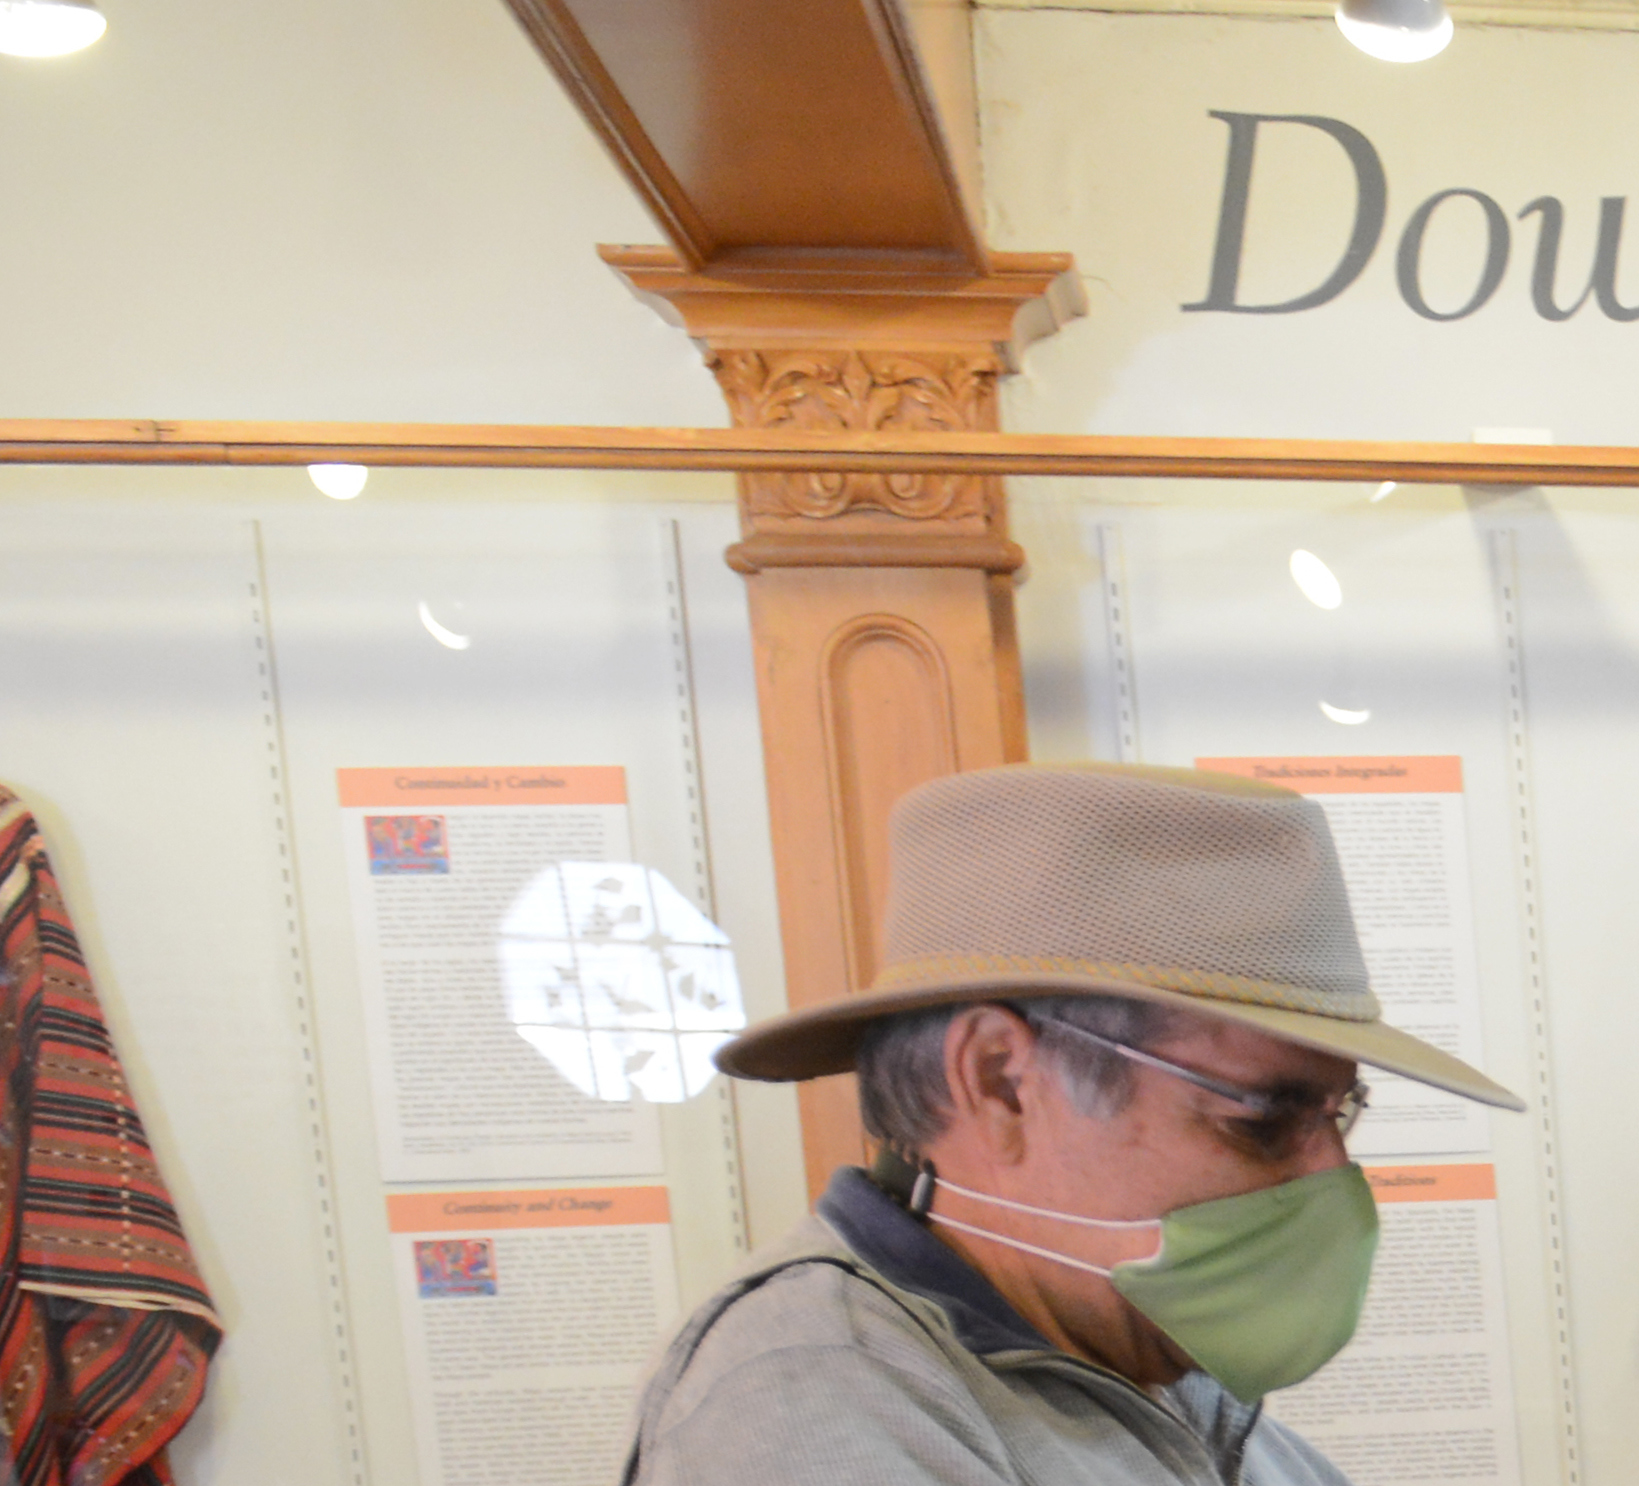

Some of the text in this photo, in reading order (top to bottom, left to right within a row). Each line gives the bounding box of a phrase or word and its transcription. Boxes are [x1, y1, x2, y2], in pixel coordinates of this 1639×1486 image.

[395, 774, 488, 789] Continuidad
[506, 774, 565, 788] Cambio
[444, 1195, 613, 1214] Continuity and Change
